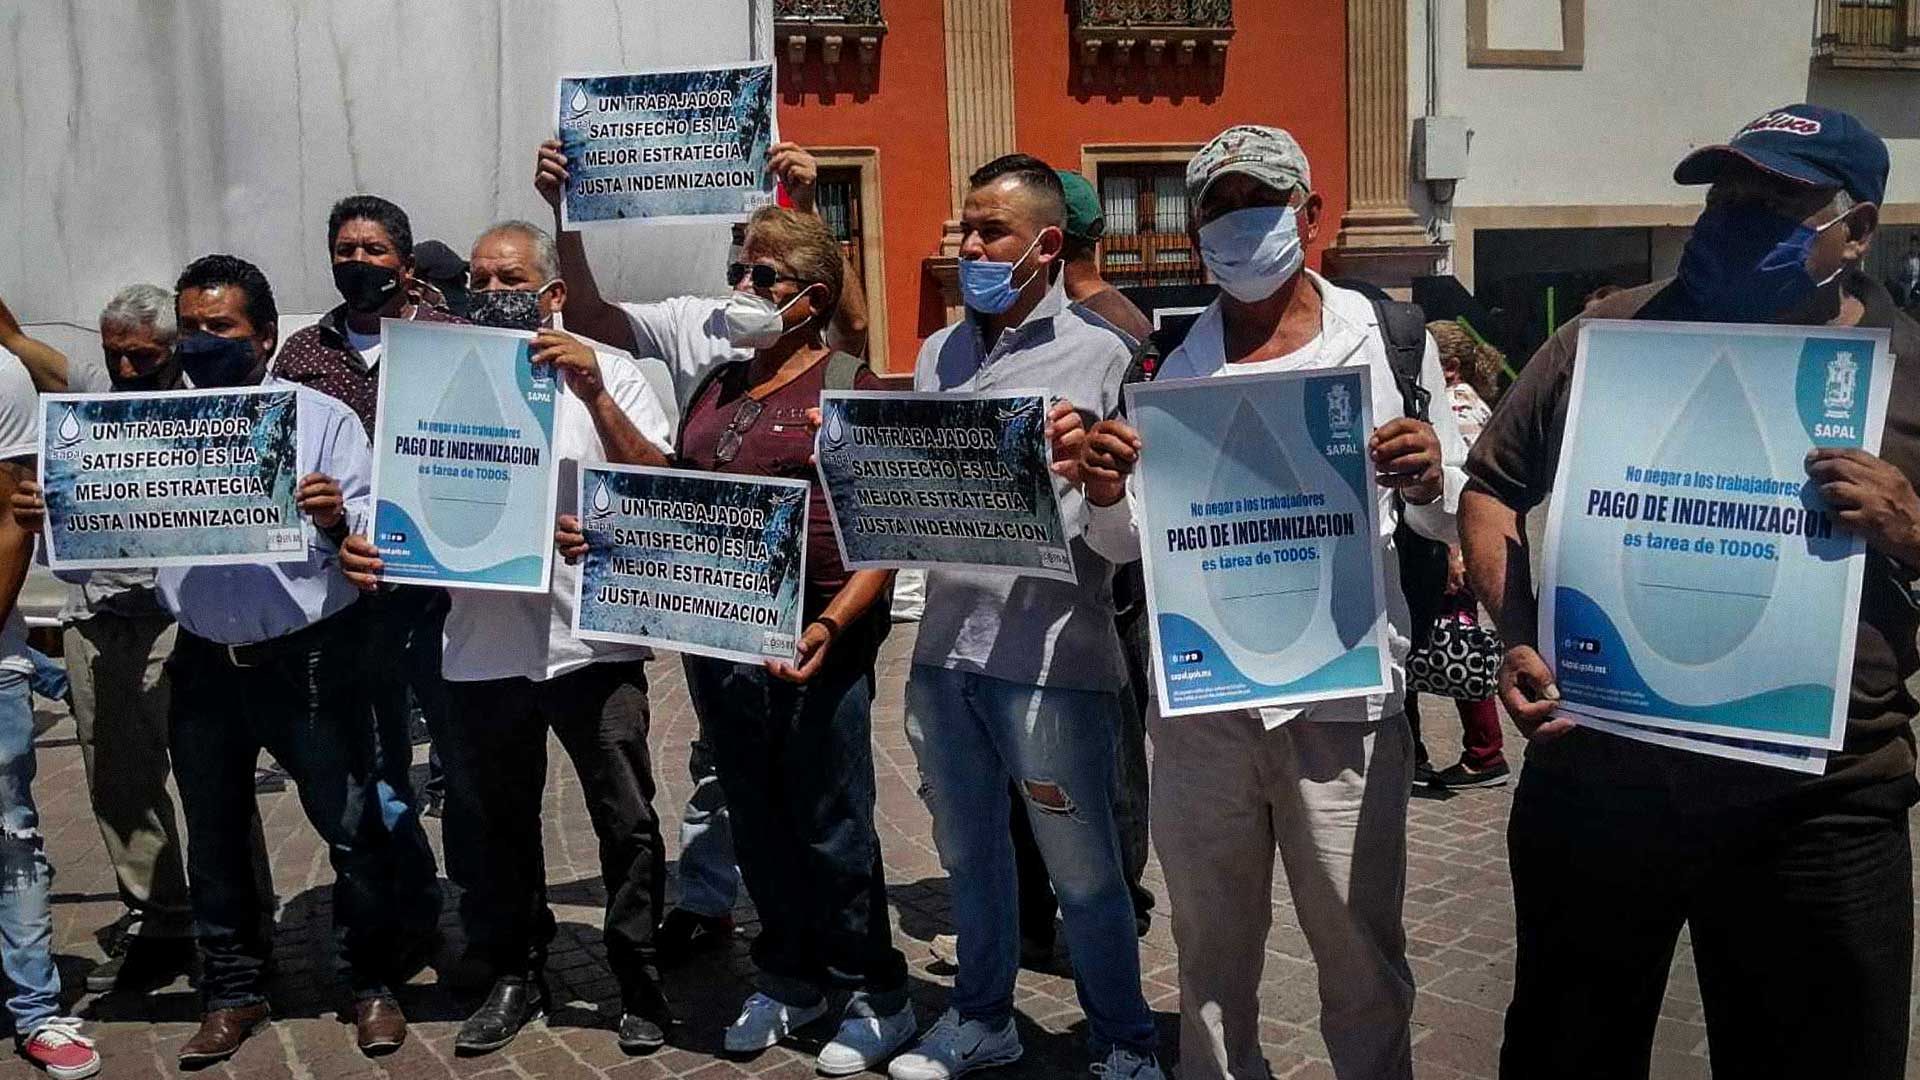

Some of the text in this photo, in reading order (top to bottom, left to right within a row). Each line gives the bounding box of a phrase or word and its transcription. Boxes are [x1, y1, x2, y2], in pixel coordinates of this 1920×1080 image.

[598, 92, 731, 113] UN TRABAJADOR
[590, 117, 737, 139] SATISFECHO ES LA
[585, 144, 741, 167] MEJOR ESTRATEGIA
[578, 171, 755, 196] JUSTA INDEMNIZACION
[528, 391, 551, 402] SAPAL
[93, 417, 250, 441] UN TRABAJADOR
[418, 419, 520, 439] No negar a los trabajadores
[853, 426, 996, 448] UN TRABAJADOR
[1814, 423, 1856, 440] SAPAL
[82, 447, 257, 470] SATISFECHO ES LA
[395, 435, 540, 466] PAGO DE INDEMNIZACION
[1326, 443, 1358, 456] SAPAL
[418, 464, 511, 481] es tarea de TODOS.
[853, 460, 1013, 480] SATISFECHO ES LA
[1626, 466, 1801, 497] No negar a los trabajadores
[76, 478, 263, 501] MEJOR ESTRATEGIA
[856, 488, 1028, 512] MEJOR ESTRATEGIA
[621, 499, 764, 529] UN TRABAJADOR
[1191, 494, 1325, 517] No negar a los trabajadores
[1587, 488, 1832, 539] PAGO DE INDEMNIZACION
[67, 507, 280, 532] JUSTA INDEMNIZACION
[855, 516, 1049, 542] JUSTA INDEMNIZACION
[614, 528, 769, 561] SATISFECHO ES LA
[1167, 513, 1355, 552] PAGO DE INDEMNIZACION
[1202, 547, 1320, 571] es tarea de TODOS.
[1623, 532, 1780, 562] es tarea de TODOS.
[612, 557, 771, 593] MEJOR ESTRATEGIA
[597, 586, 779, 626] JUSTA INDEMNIZACION
